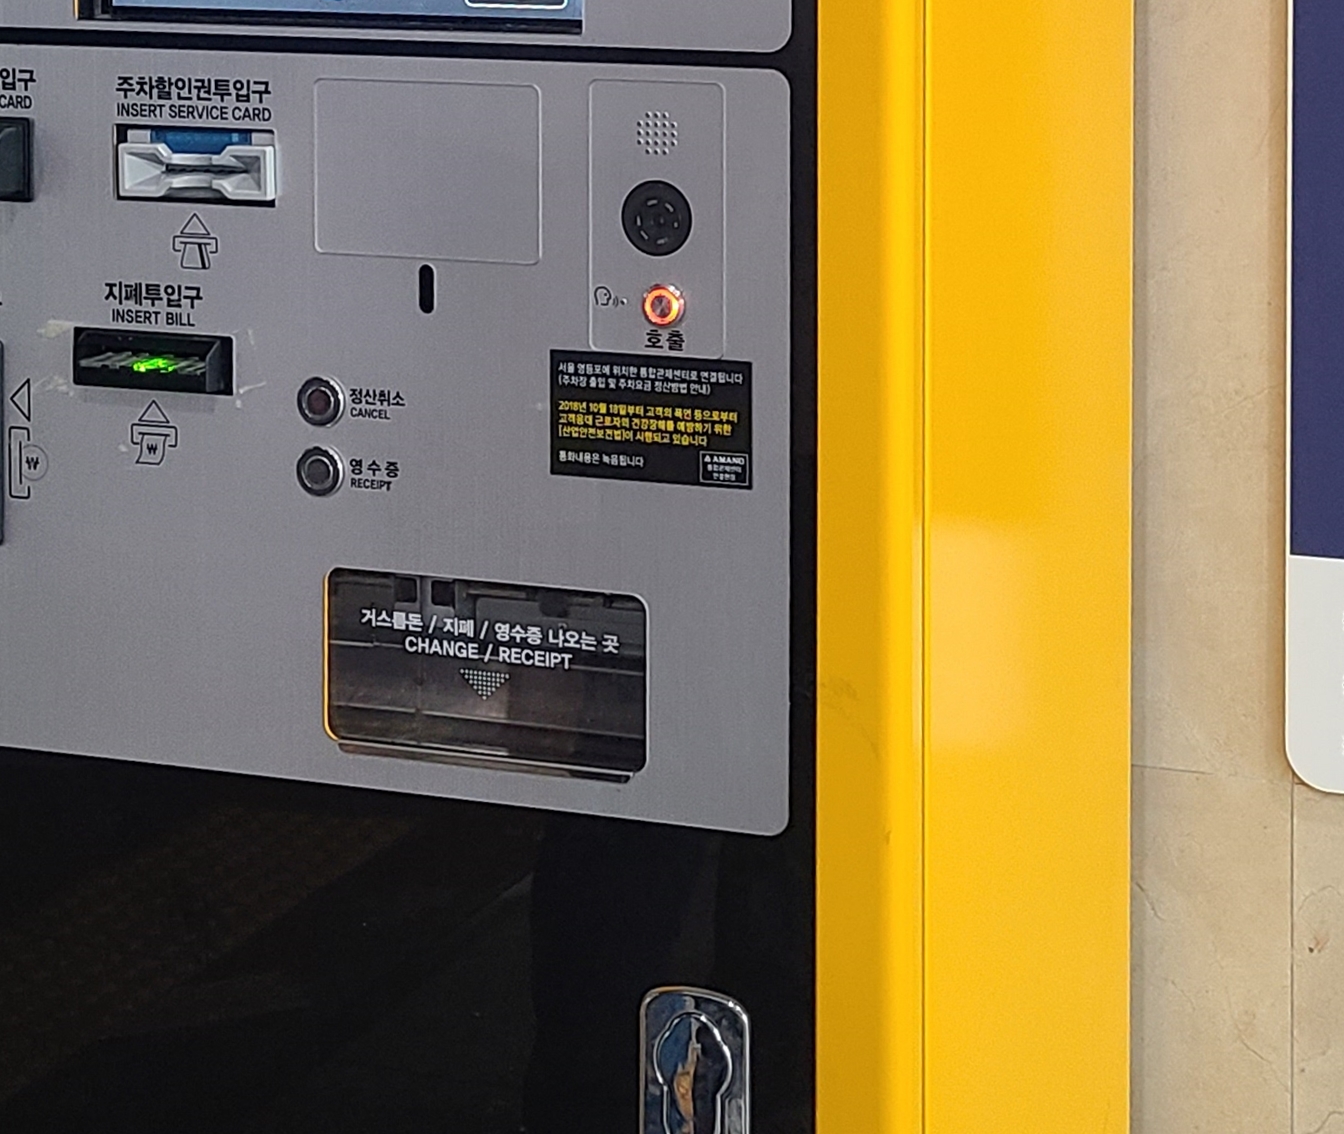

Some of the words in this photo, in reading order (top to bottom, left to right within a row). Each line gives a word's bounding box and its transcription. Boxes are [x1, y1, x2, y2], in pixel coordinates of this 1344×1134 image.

[115, 76, 271, 104] 주차할인권투입구
[116, 102, 166, 118] INSERT
[168, 104, 228, 120] SERVICE
[231, 106, 271, 122] CARD
[104, 281, 203, 309] 지폐투입구
[112, 308, 161, 325] INSERT
[165, 311, 195, 327] BILL
[644, 329, 685, 351] 호출
[349, 388, 405, 407] 정산취소
[350, 406, 391, 420] CANCEL
[349, 458, 399, 478] 영수증
[350, 477, 392, 491] RECEIPT
[442, 617, 474, 637] 지폐
[494, 622, 542, 645] 영수증
[548, 629, 597, 651] 나오는
[602, 634, 619, 653] 곳
[405, 636, 479, 660] CHANGE
[498, 646, 573, 669] RECEIPT
